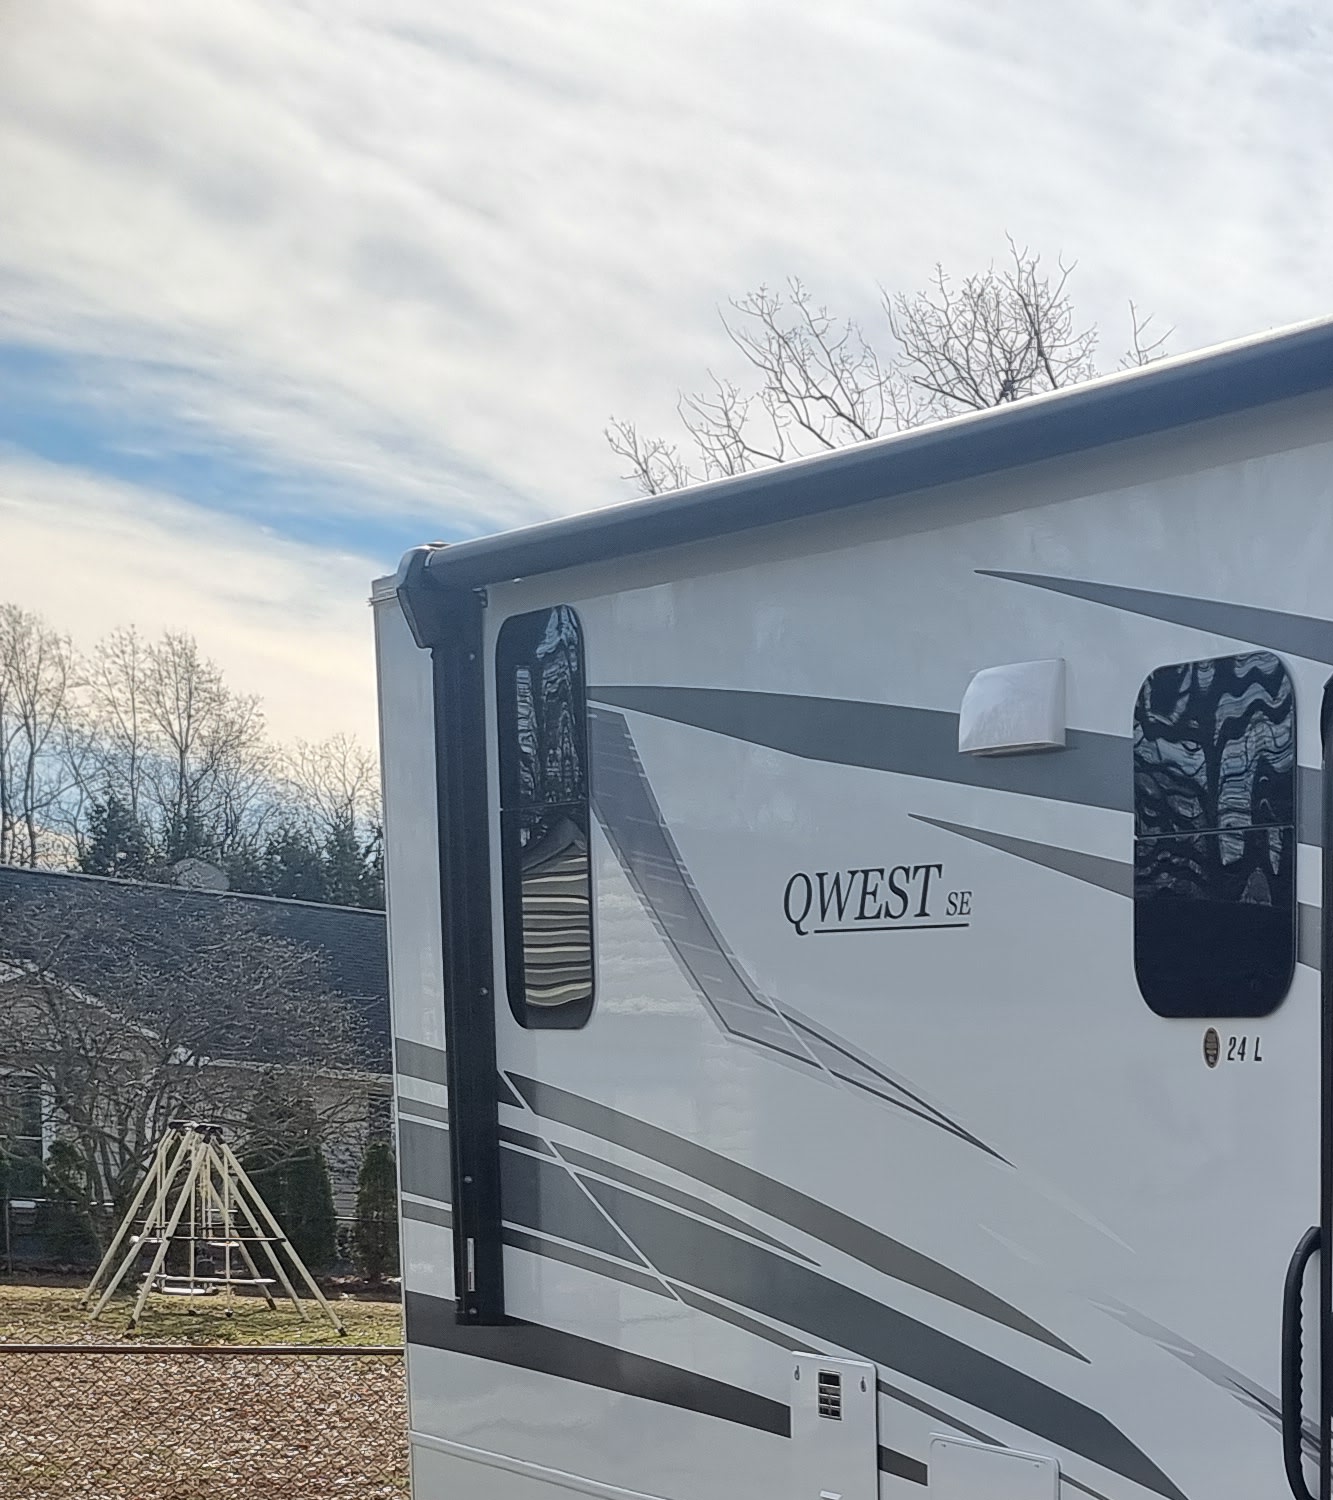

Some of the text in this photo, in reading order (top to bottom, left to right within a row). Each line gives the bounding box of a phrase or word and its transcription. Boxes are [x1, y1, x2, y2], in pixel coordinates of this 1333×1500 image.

[783, 864, 972, 936] QWEST SE
[1227, 1036, 1263, 1062] 24 L
